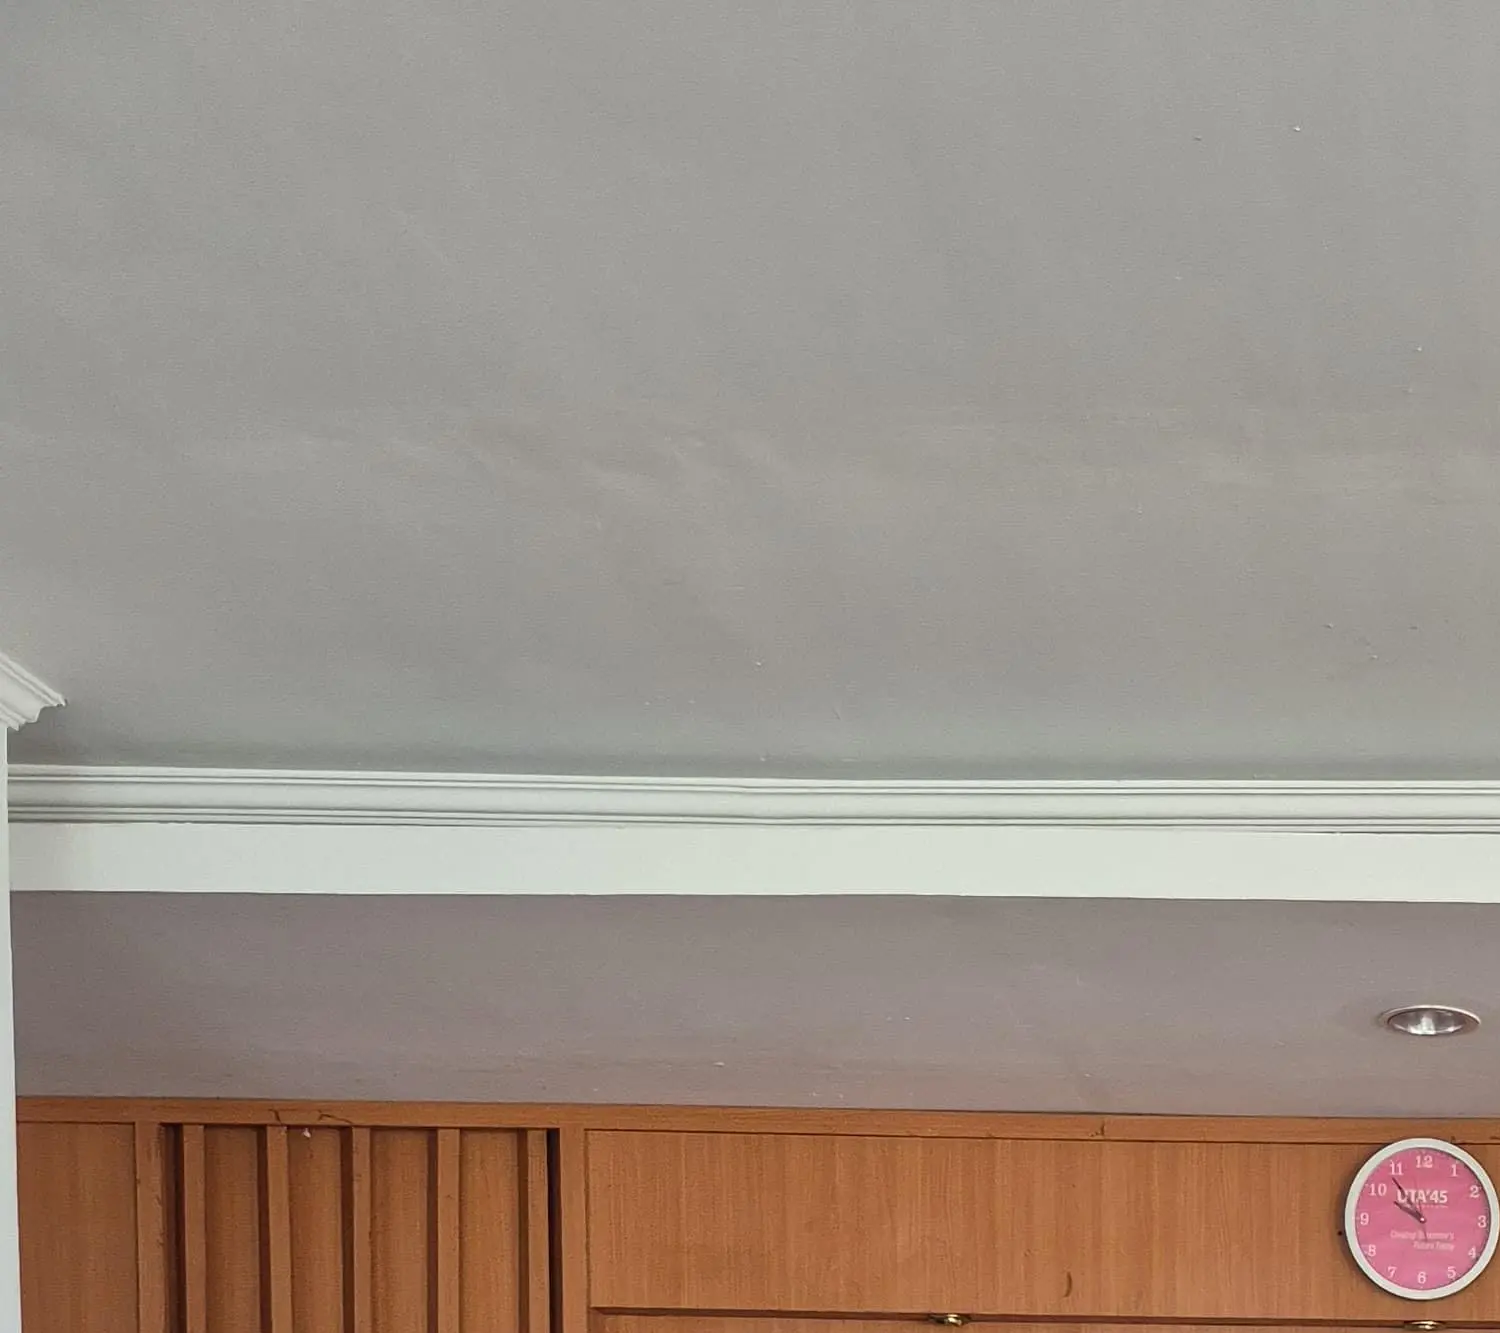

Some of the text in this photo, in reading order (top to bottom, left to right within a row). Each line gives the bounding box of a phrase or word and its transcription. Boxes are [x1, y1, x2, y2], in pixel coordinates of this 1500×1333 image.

[1415, 1155, 1433, 1168] 12
[1390, 1161, 1403, 1176] 11
[1451, 1164, 1458, 1177] 1
[1369, 1183, 1387, 1197] 10
[1470, 1185, 1480, 1198] 2
[1360, 1212, 1369, 1226] 9
[1477, 1215, 1487, 1228] 3
[1367, 1244, 1377, 1256] 8
[1468, 1246, 1477, 1259] 4
[1387, 1266, 1397, 1278] 7
[1417, 1271, 1427, 1284] 6
[1447, 1266, 1457, 1279] 5
